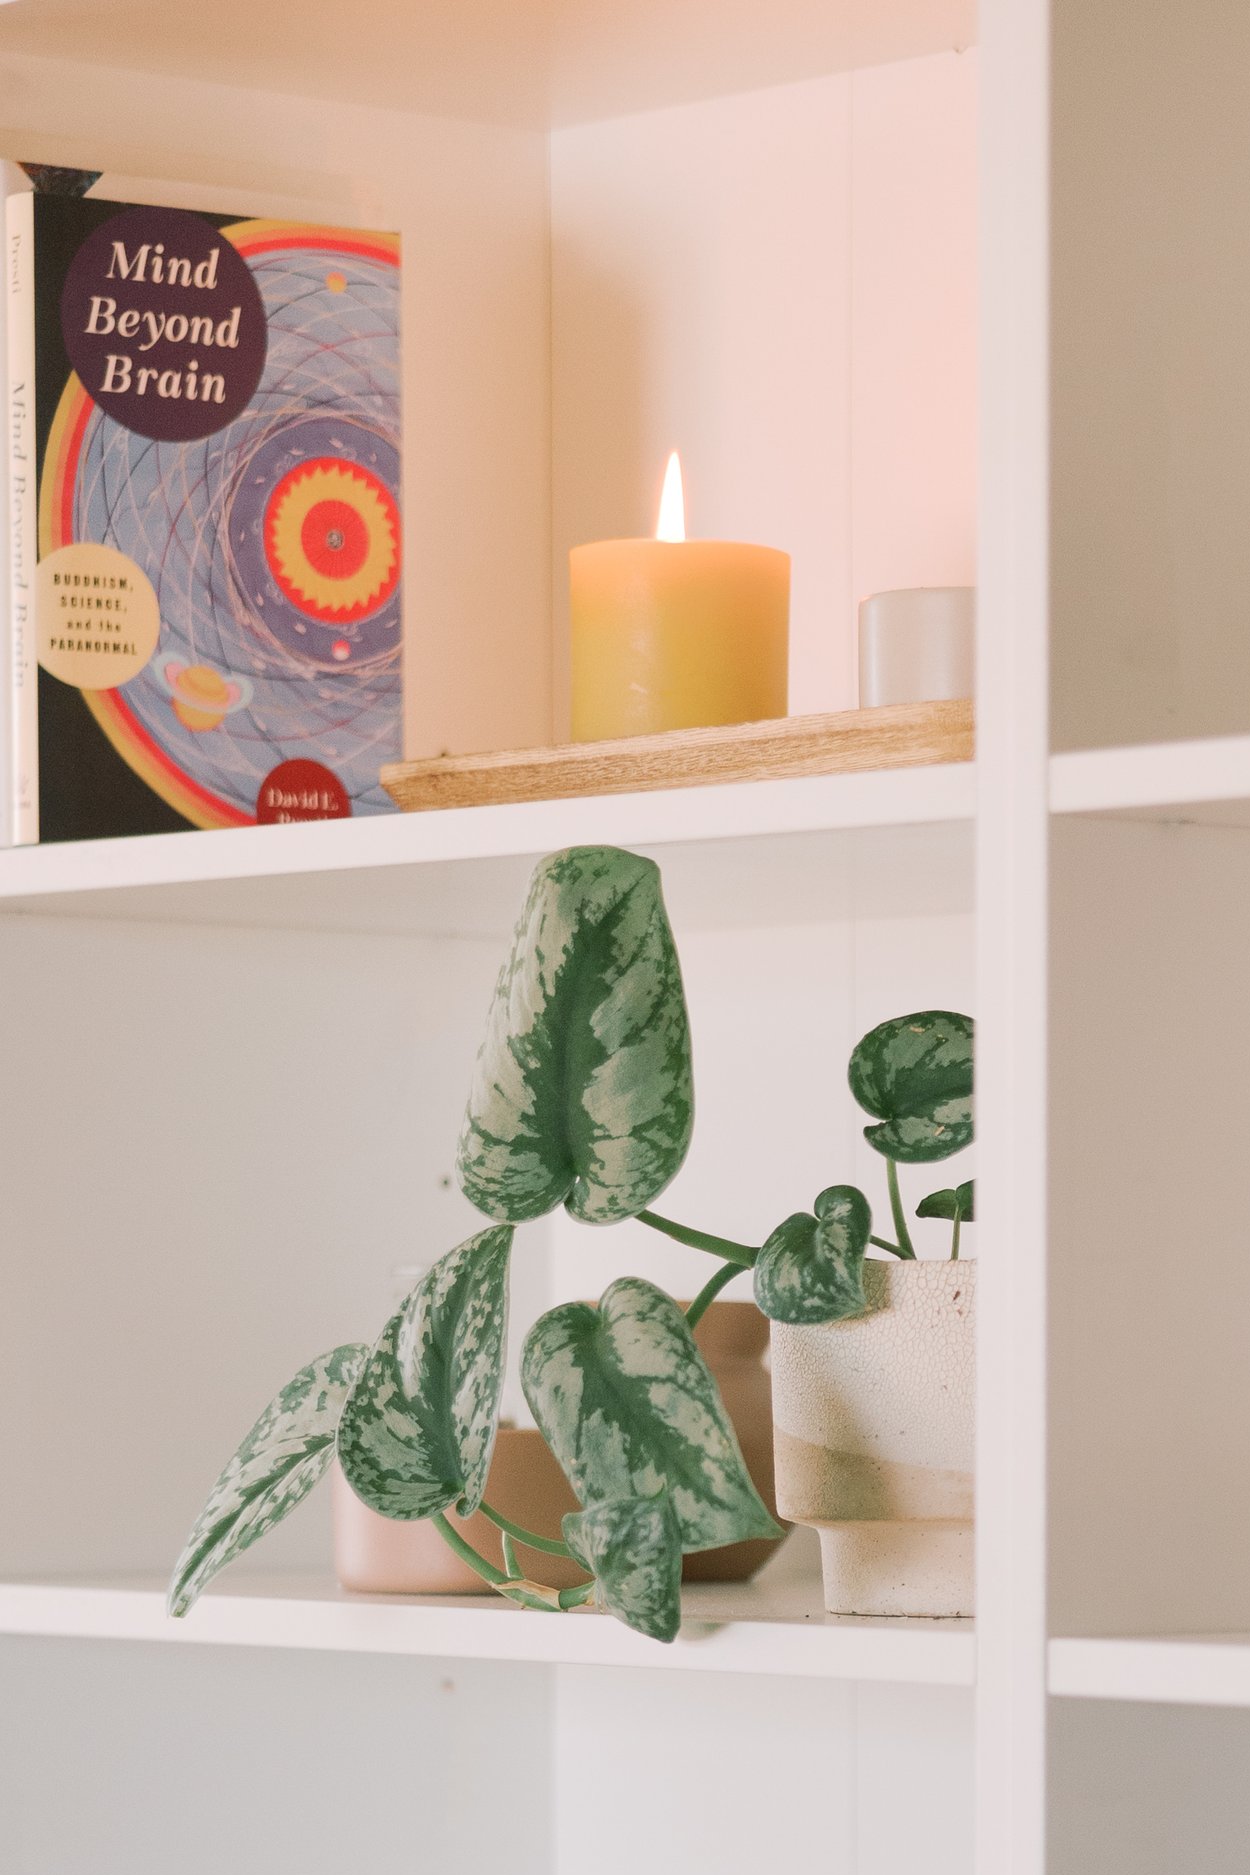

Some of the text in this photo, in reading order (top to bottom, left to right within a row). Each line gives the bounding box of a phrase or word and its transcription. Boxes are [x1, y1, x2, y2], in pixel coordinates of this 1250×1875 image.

[105, 241, 220, 289] Mind
[84, 296, 242, 351] Beyond
[100, 354, 226, 404] Brain
[12, 382, 28, 461] Mind
[50, 638, 137, 655] PARANORMAL
[66, 620, 122, 632] and the
[267, 788, 319, 811] David
